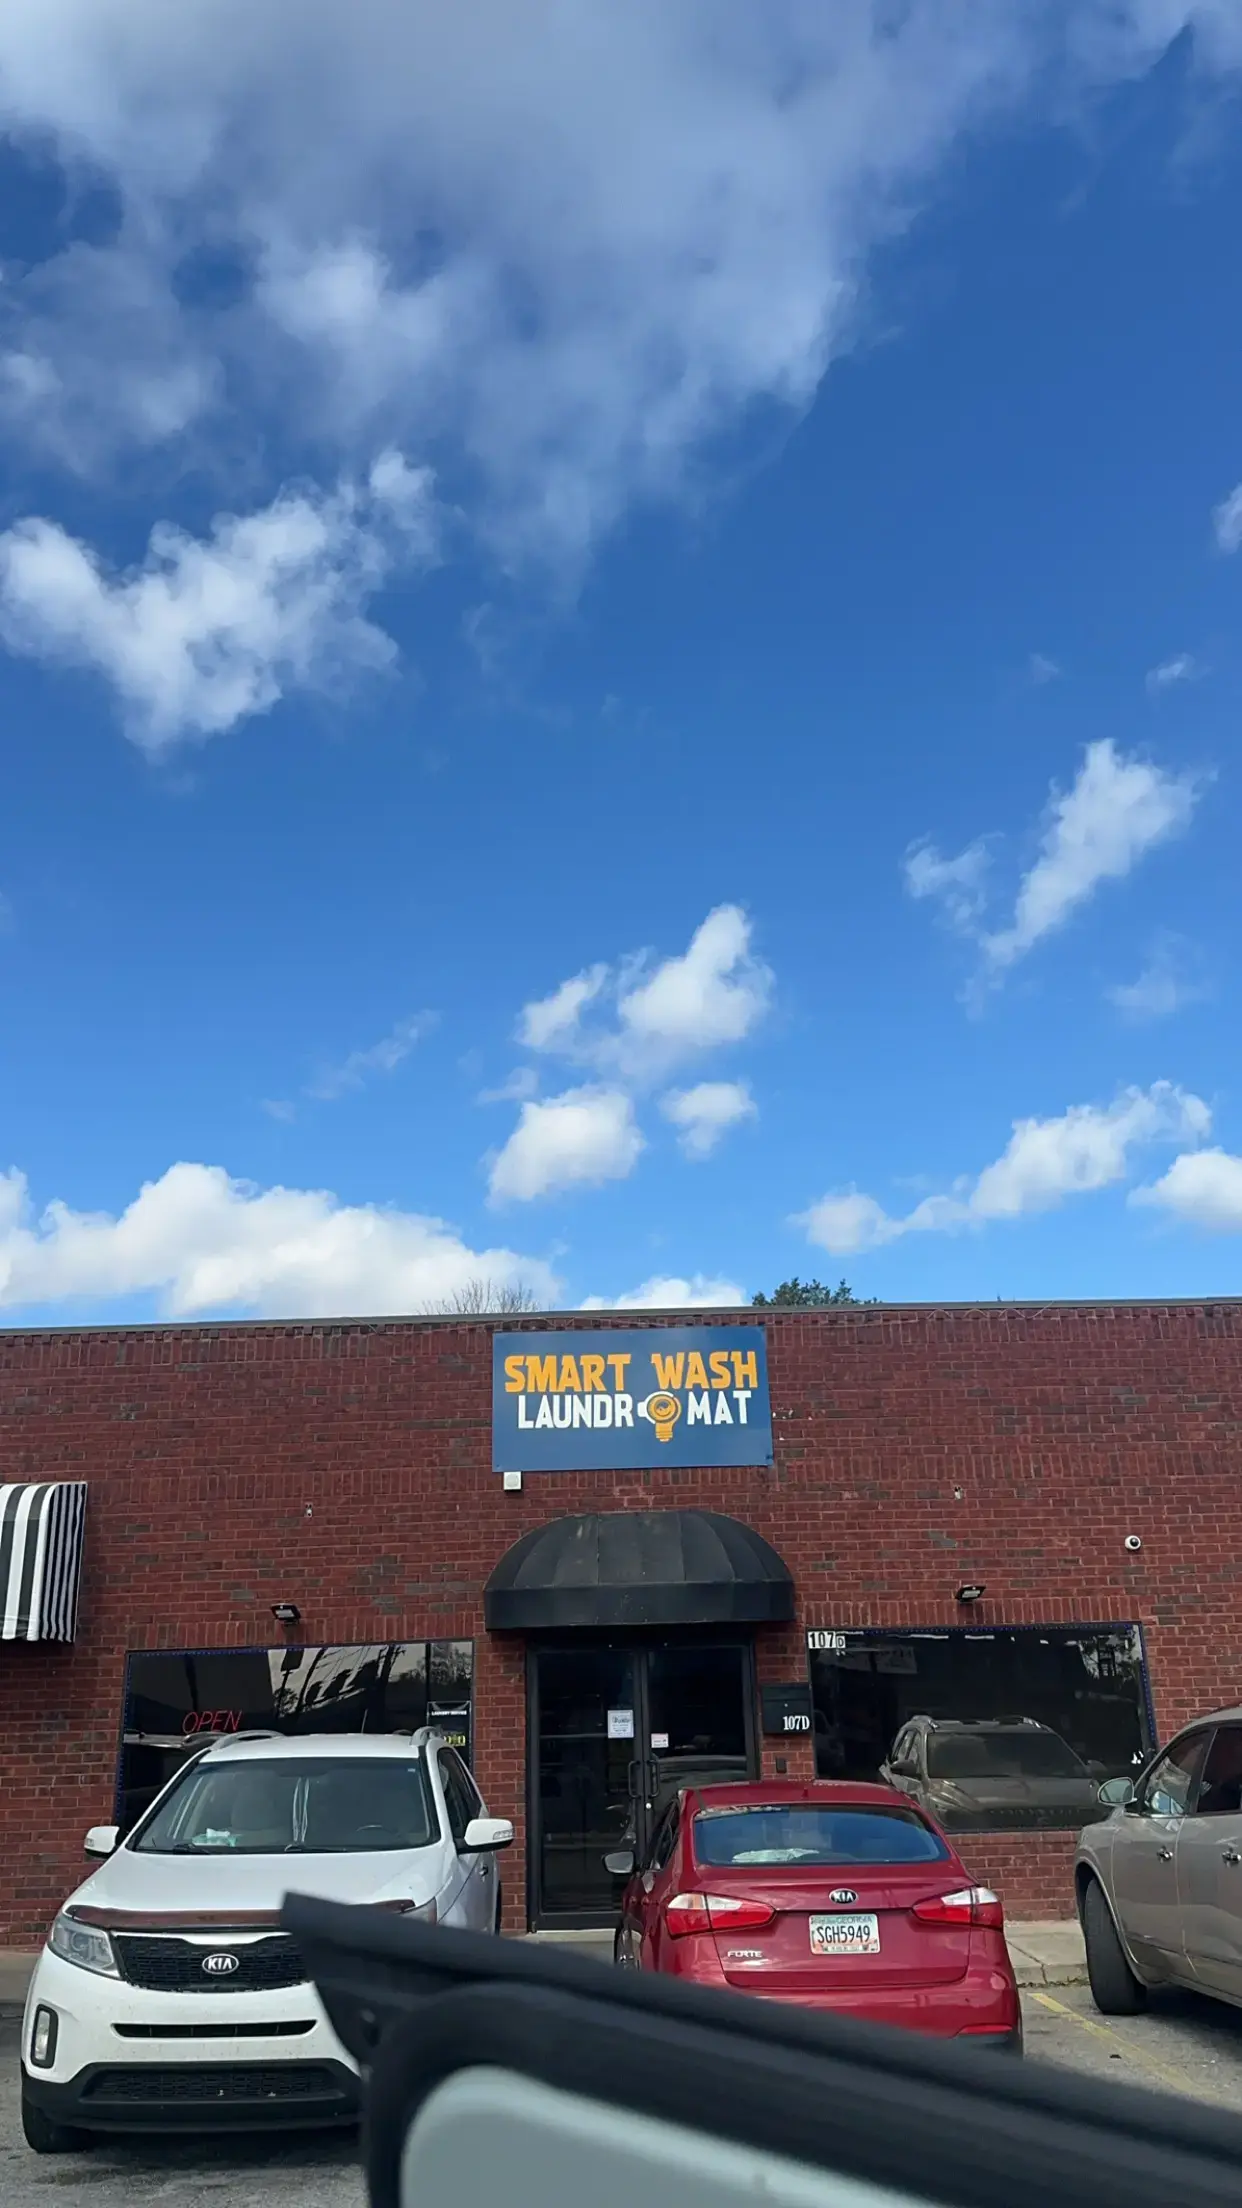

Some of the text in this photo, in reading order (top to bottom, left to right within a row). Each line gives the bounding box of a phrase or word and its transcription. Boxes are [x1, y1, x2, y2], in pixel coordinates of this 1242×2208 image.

[504, 1351, 758, 1392] SMART WASH
[182, 1710, 242, 1733] OPEN
[783, 1715, 810, 1731] 107D
[833, 1891, 854, 1902] KIA
[816, 1925, 871, 1944] SGH5949
[727, 1950, 763, 1958] FORTE
[207, 1957, 233, 1970] KIA
